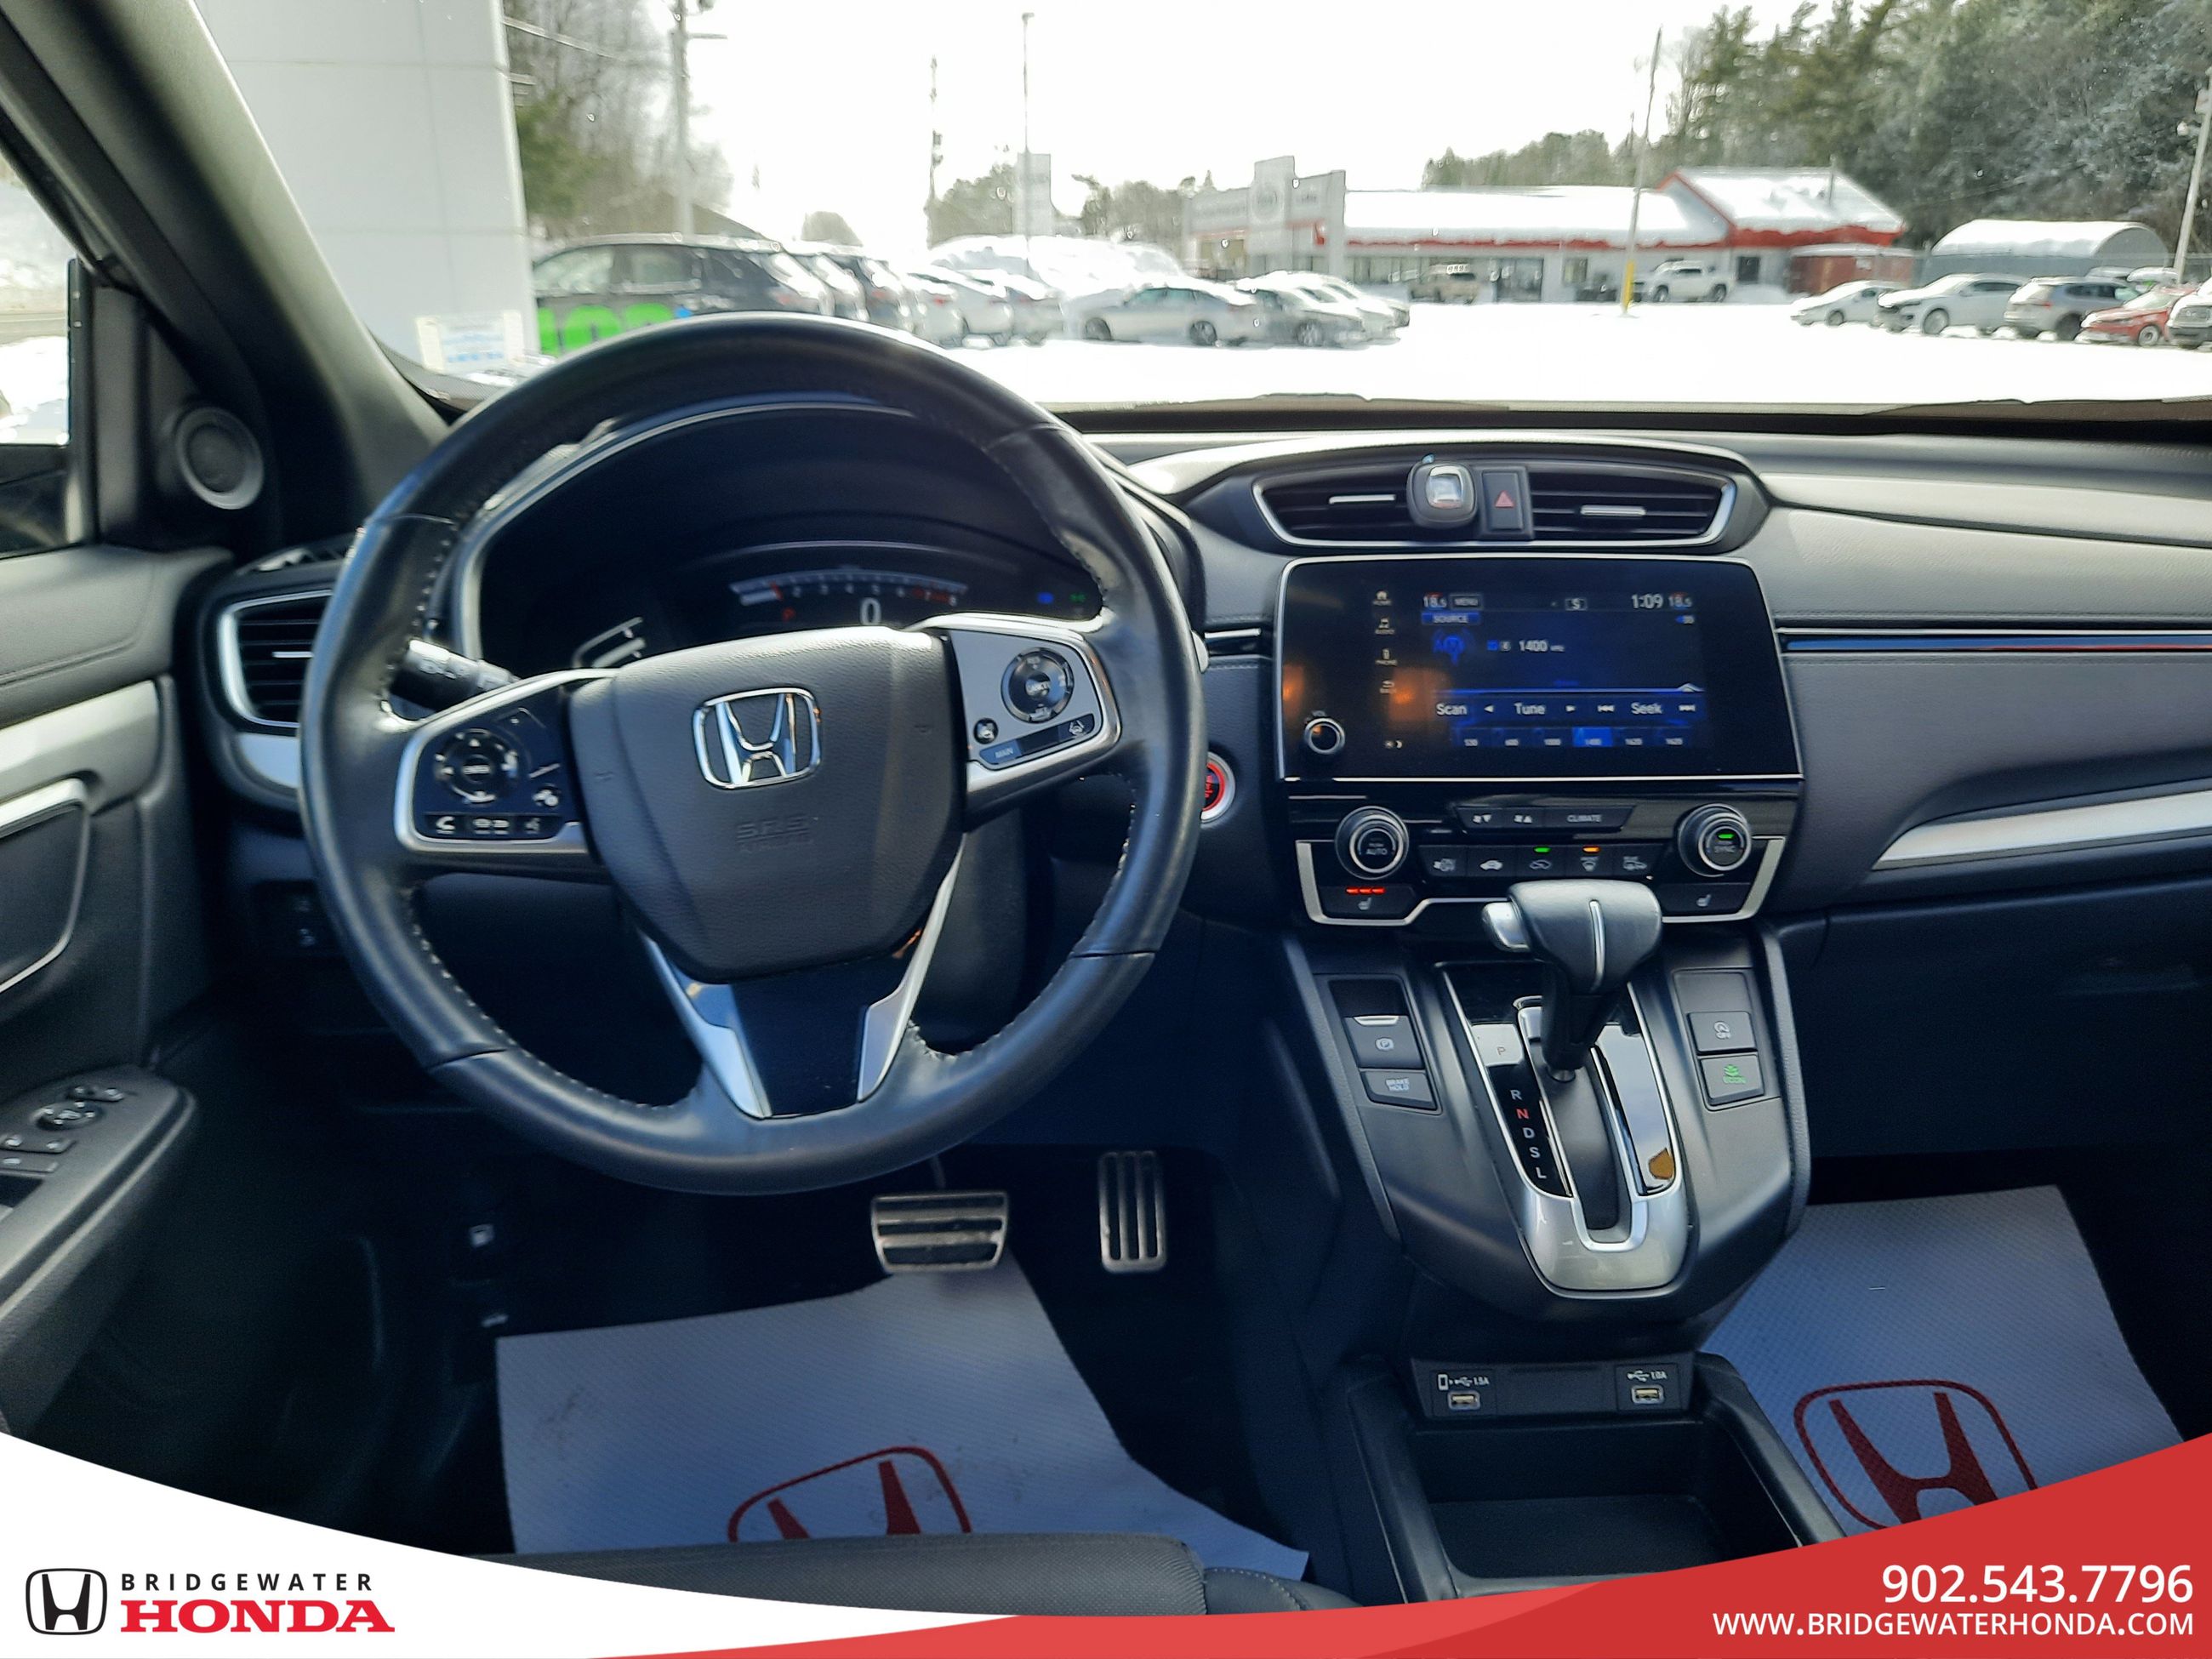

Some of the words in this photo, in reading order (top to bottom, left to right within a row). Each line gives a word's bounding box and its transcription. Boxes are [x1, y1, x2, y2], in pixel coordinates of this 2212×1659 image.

[1631, 594, 1663, 609] 1:09
[860, 597, 881, 625] 0
[1433, 614, 1469, 624] SOURCE
[1519, 639, 1548, 653] 1400
[1436, 703, 1468, 715] Scan
[1514, 702, 1546, 715] Tune
[1630, 701, 1662, 714] Seek
[995, 748, 1015, 759] MAIN
[1567, 813, 1602, 824] CLIMATE
[1365, 847, 1388, 856] AUTO
[1497, 1046, 1506, 1056] P
[1510, 1089, 1522, 1101] R
[1517, 1108, 1530, 1120] N
[1523, 1127, 1535, 1139] D
[1529, 1146, 1541, 1159] S
[1536, 1166, 1547, 1179] L
